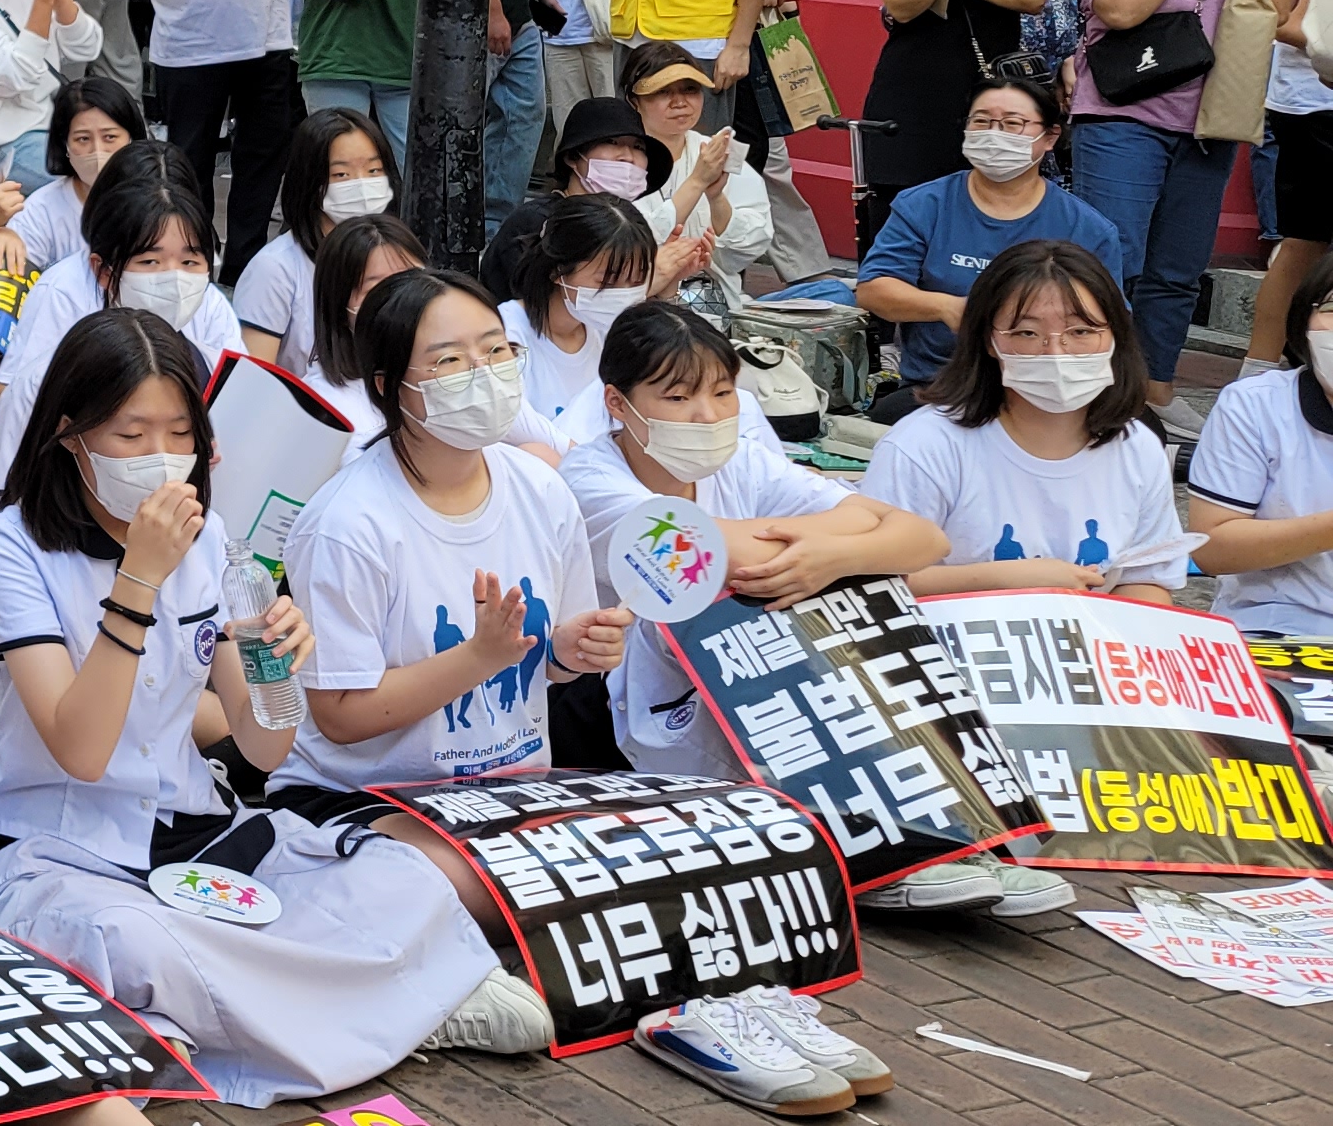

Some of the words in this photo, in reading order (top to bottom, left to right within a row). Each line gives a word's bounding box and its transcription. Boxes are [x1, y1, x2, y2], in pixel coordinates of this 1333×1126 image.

[701, 609, 812, 687] 제발
[791, 585, 891, 653] 그만
[414, 784, 520, 830] 제발
[503, 776, 590, 814] 그만
[433, 749, 471, 762] Father
[473, 744, 493, 758] And
[808, 744, 963, 858] 너무
[467, 789, 818, 912] 불법도로점용
[547, 901, 674, 1010] 너무
[679, 865, 841, 984] 싫다!!!
[712, 1041, 734, 1063] FILA
